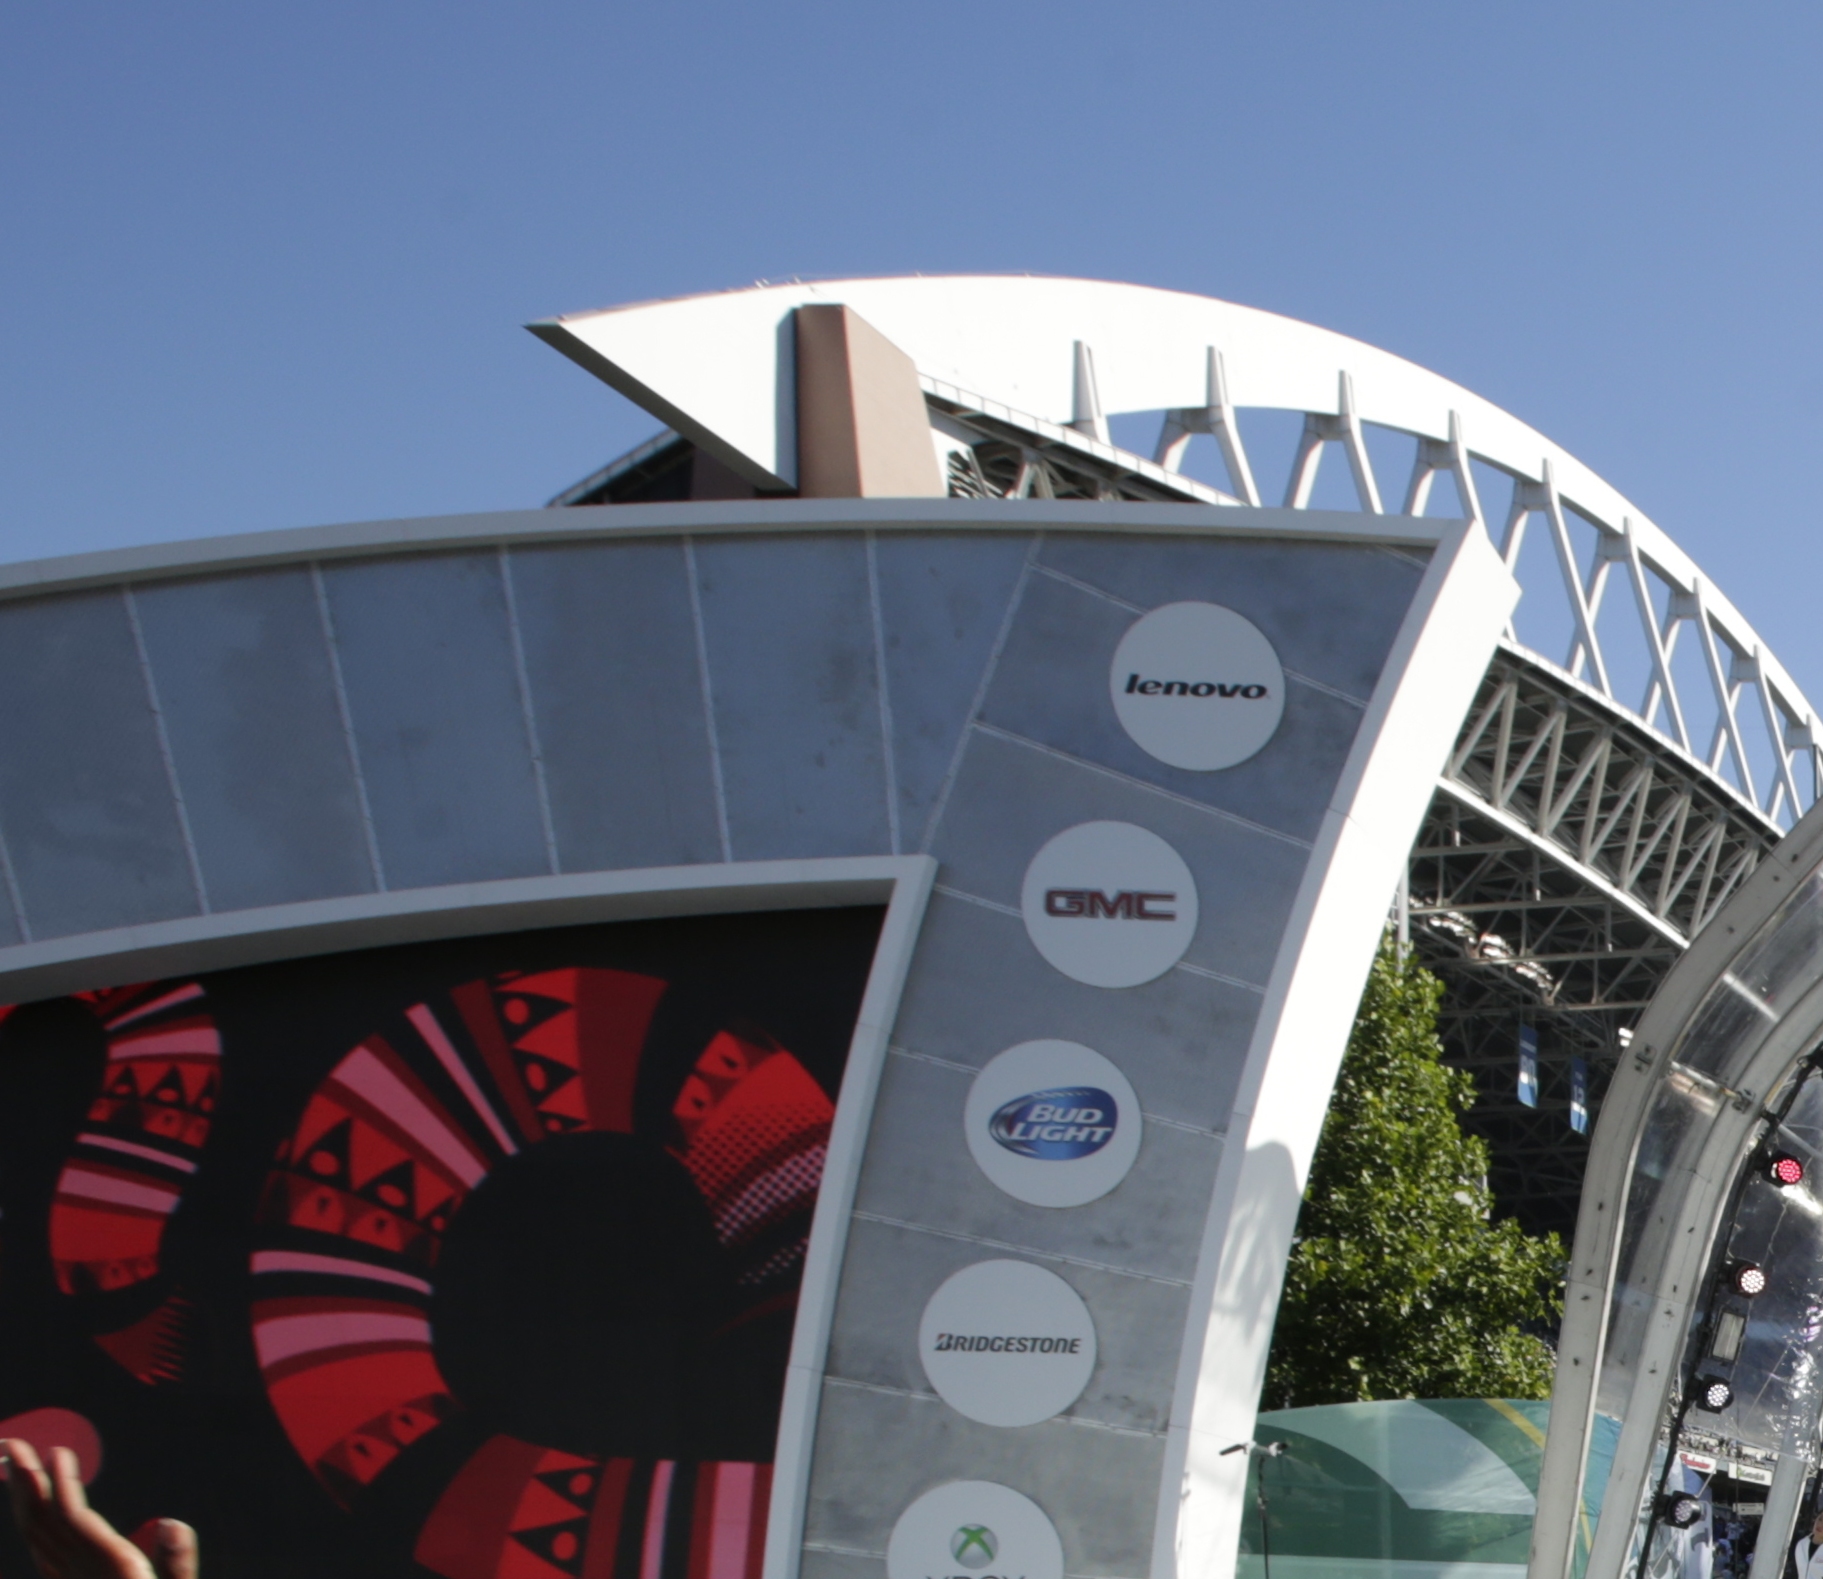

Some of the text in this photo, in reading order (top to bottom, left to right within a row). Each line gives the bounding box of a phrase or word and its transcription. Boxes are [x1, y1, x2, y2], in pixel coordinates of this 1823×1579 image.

[1124, 673, 1268, 700] lenovo
[1045, 889, 1177, 921] GMC
[1027, 1104, 1104, 1126] BUD
[1010, 1123, 1113, 1144] LIGHT
[934, 1331, 1081, 1355] BRIDGESTONE
